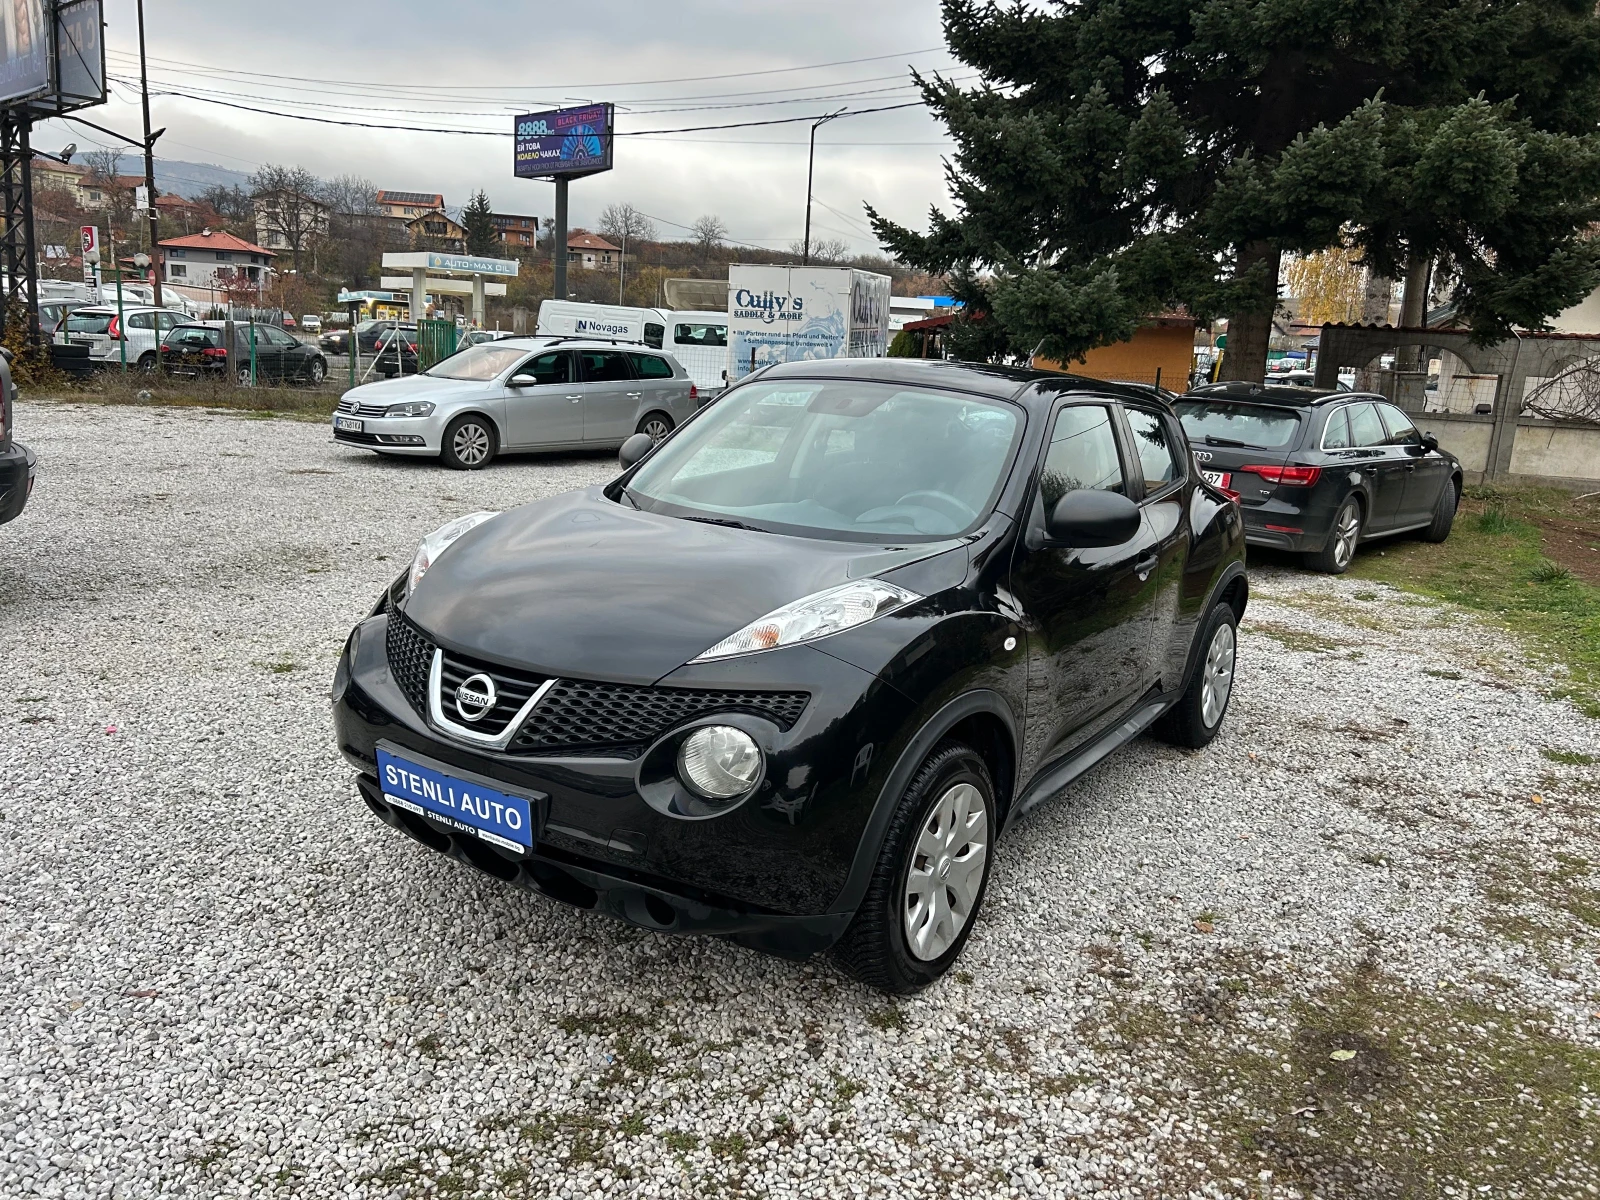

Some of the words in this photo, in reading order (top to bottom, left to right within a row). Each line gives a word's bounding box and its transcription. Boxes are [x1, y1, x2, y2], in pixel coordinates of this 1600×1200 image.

[557, 116, 577, 126] BLACK
[579, 111, 601, 122] FRIDAY
[517, 142, 525, 152] ЕЙ
[526, 142, 541, 150] ТОВА
[517, 152, 539, 161] КОЛЕЛО
[540, 149, 561, 158] ЧАКАХ
[495, 264, 510, 273] OIL
[735, 289, 803, 311] Cully's
[768, 311, 775, 319] &
[779, 312, 803, 320] MORE
[589, 321, 629, 334] Novagas
[747, 338, 795, 347] Sattelanpassung
[457, 688, 489, 706] NISSAN
[385, 764, 455, 808] STENLI
[460, 792, 522, 830] AUTO
[427, 811, 452, 826] STENLI
[453, 820, 476, 835] AUTO
